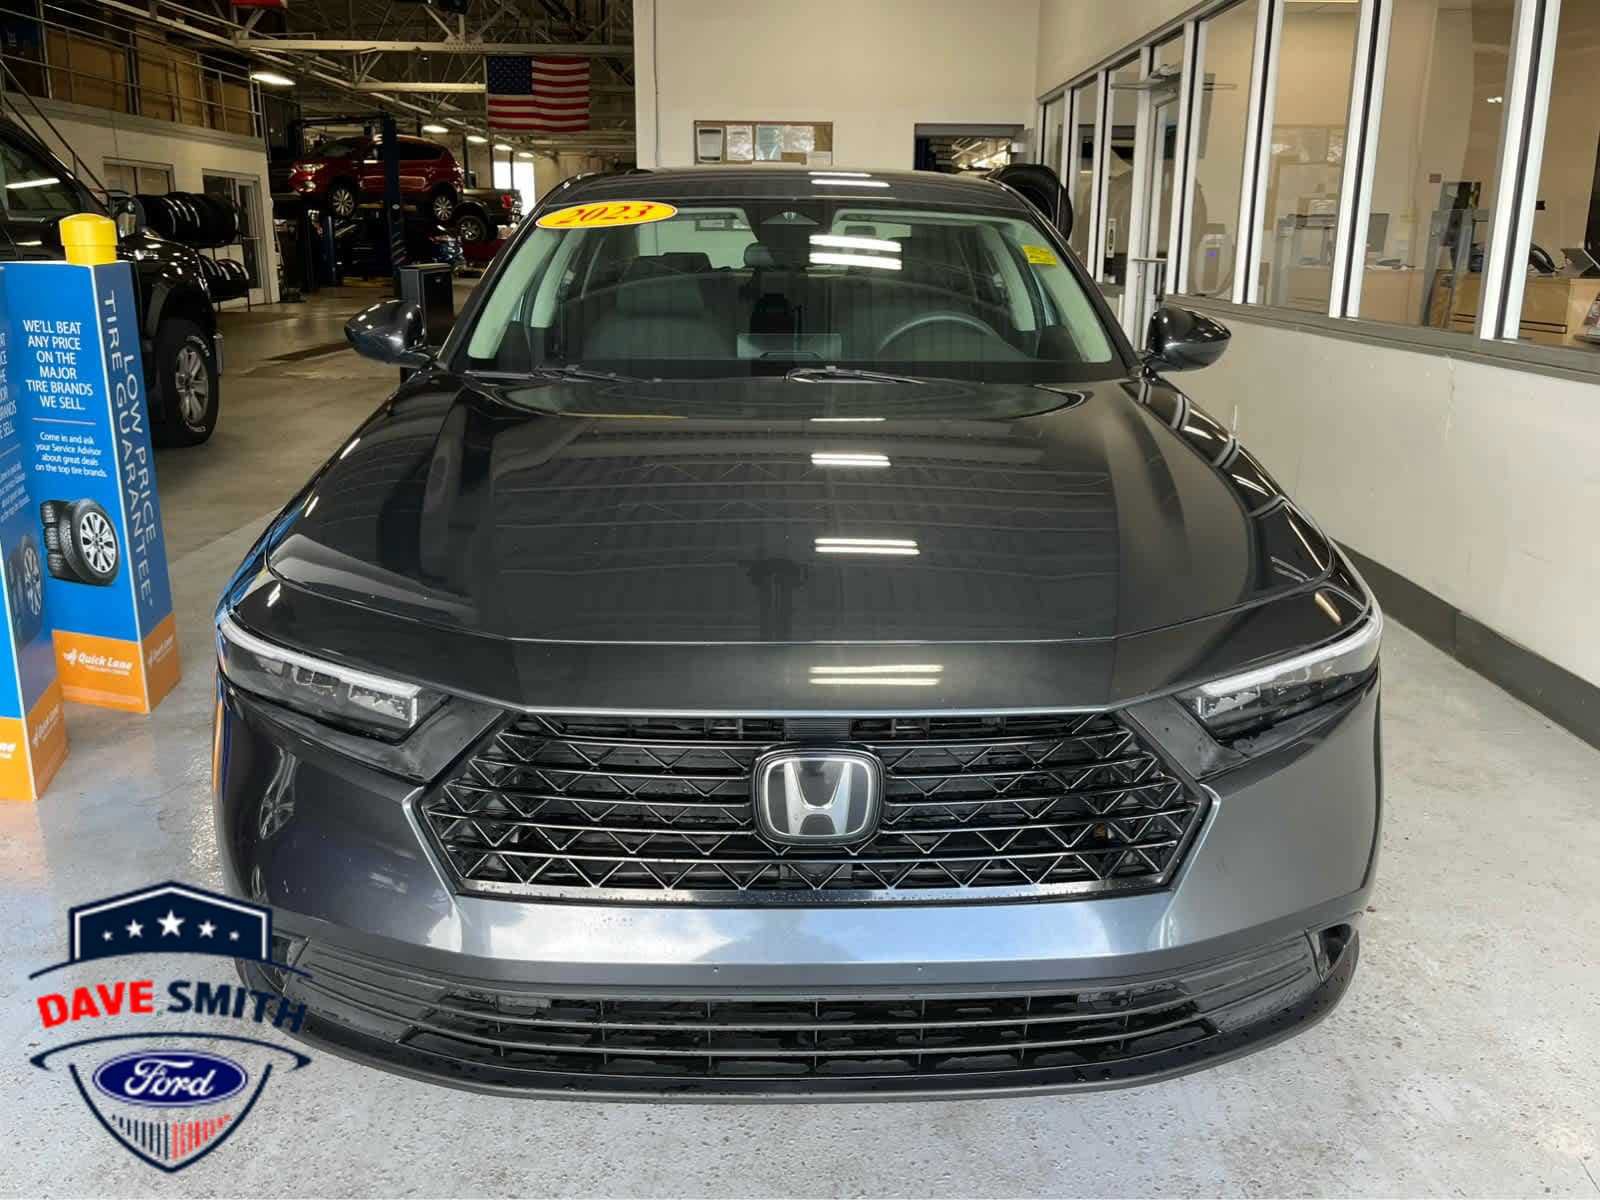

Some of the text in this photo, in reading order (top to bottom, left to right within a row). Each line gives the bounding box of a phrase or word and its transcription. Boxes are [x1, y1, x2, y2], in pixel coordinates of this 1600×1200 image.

[556, 204, 654, 224] 2023
[23, 319, 82, 335] WE'LL BEAT
[104, 290, 122, 370] TIRE
[28, 335, 81, 351] ANY PRICE
[36, 350, 76, 365] ON THE
[40, 365, 77, 380] MAJOR
[25, 379, 48, 393] TIRE
[51, 382, 93, 397] BRANDS
[40, 395, 57, 409] WE
[40, 432, 95, 445] Come in and ask
[35, 443, 51, 453] your
[52, 443, 76, 454] Service
[124, 354, 156, 544] LOW PRICE
[42, 453, 62, 463] about
[63, 456, 80, 466] great
[35, 464, 45, 472] on
[45, 463, 57, 473] the
[58, 465, 71, 475] top
[78, 651, 107, 667] Quick
[107, 657, 133, 671] Lane
